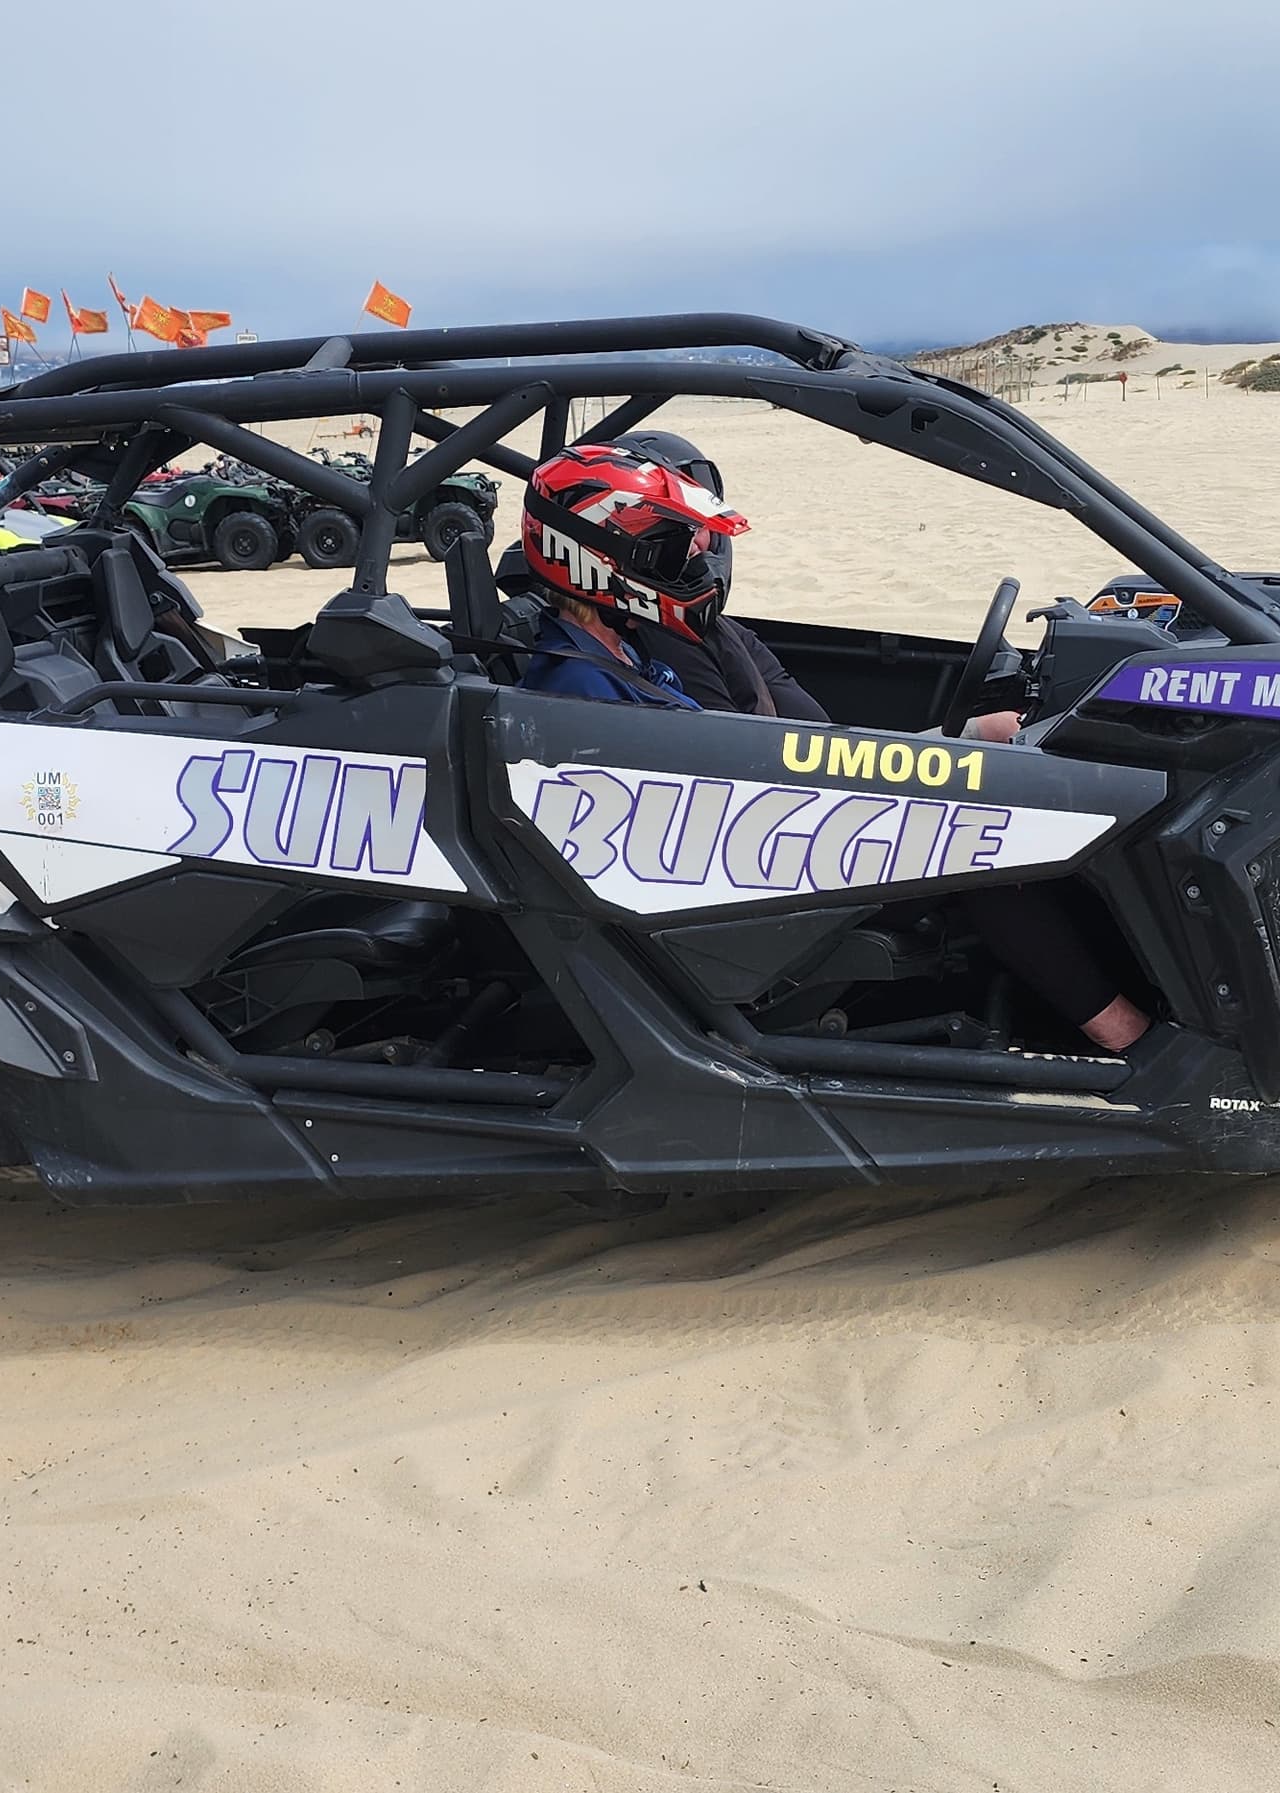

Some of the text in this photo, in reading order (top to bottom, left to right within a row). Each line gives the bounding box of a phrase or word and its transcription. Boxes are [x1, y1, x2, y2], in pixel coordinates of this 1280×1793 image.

[1139, 667, 1242, 705] RENT
[782, 732, 985, 791] UM001
[36, 771, 62, 785] UM
[37, 812, 64, 826] 001
[166, 749, 1012, 892] SUN BUGGIE
[1209, 1097, 1261, 1113] ROTAX
